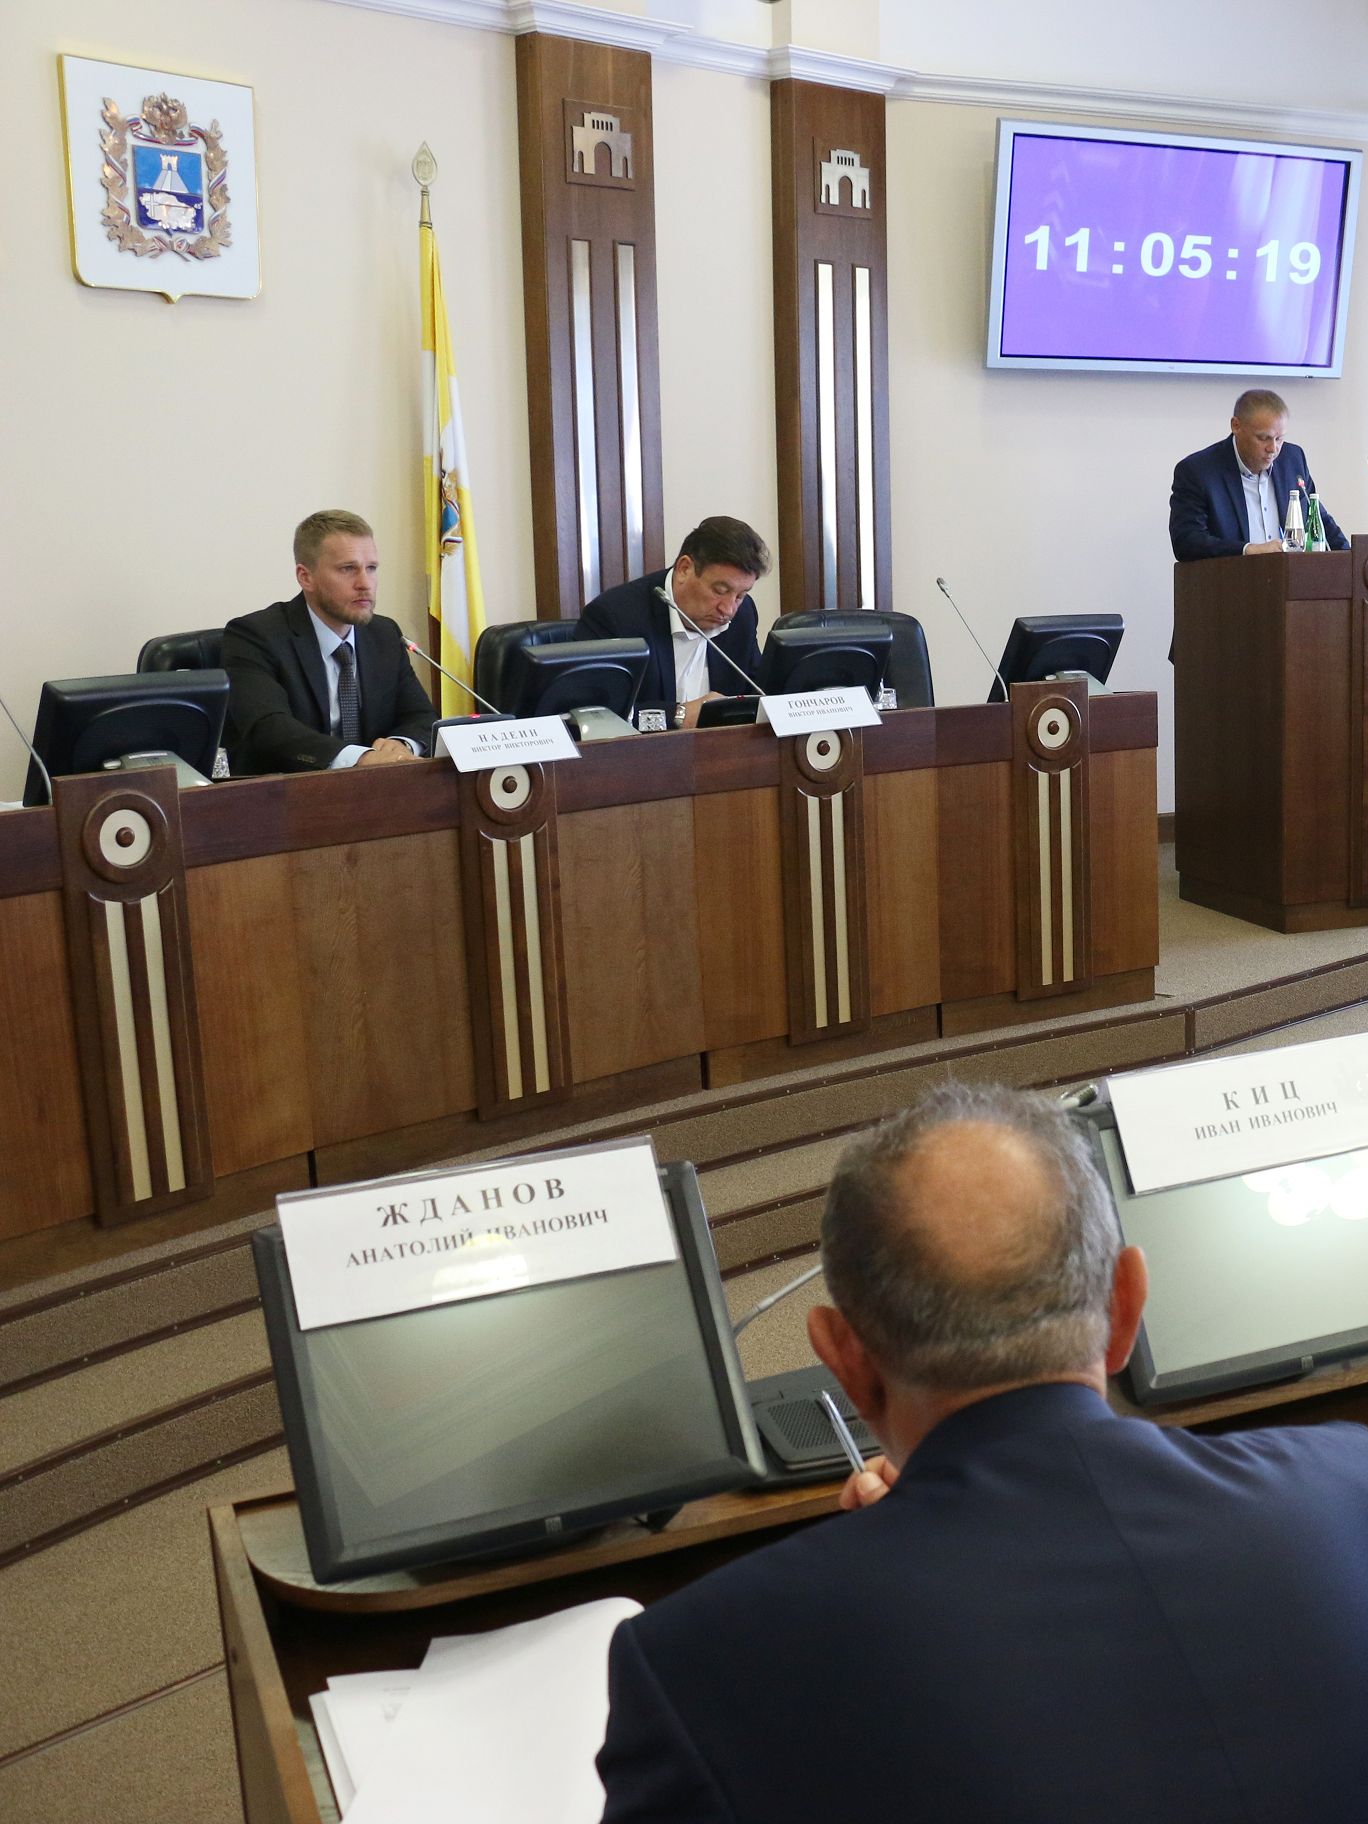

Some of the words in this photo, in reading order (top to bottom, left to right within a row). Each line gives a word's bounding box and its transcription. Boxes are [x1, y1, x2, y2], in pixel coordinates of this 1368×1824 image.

[788, 696, 845, 709] ГОНЧАРОВ
[788, 710, 815, 718] ВИКТОР
[816, 706, 853, 716] ИВАНОВИЧ
[471, 744, 502, 753] ВИКТОР
[504, 738, 554, 749] ВИКТОРОВИЧ
[478, 729, 538, 742] НАДЕИН
[1222, 1080, 1301, 1111] КИЦ
[1194, 1120, 1241, 1140] ИВАН
[1248, 1102, 1338, 1130] ИВАНОВИЧ
[376, 1177, 566, 1228] ЖДАНОВ
[345, 1228, 476, 1268] АНАТОЛИЙ
[484, 1208, 609, 1243] ИВАНОВИЧ
